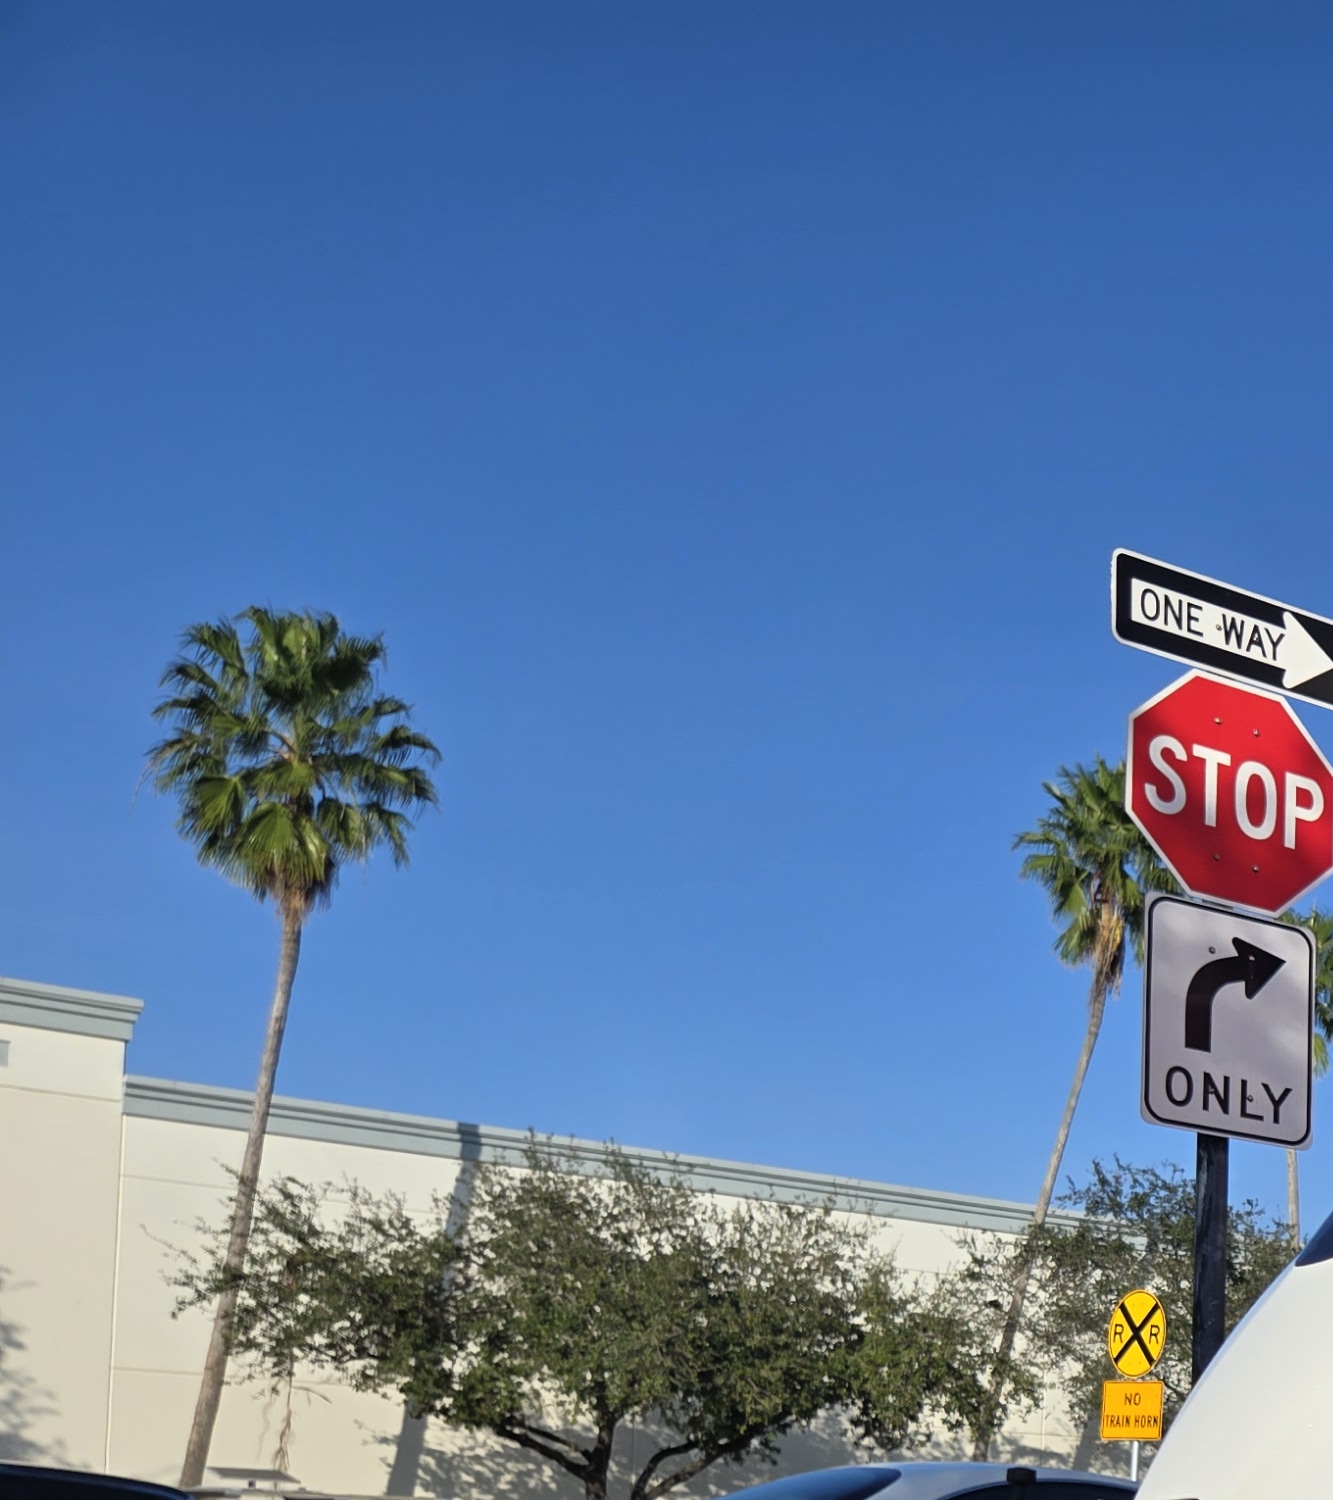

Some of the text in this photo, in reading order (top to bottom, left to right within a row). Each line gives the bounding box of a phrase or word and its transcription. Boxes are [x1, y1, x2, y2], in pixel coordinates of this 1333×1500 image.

[1140, 587, 1286, 662] ONE WAY
[1144, 734, 1325, 850] STOP
[1165, 1066, 1293, 1125] ONLY
[1105, 1414, 1159, 1429] TRAIN HORN
[1124, 1392, 1141, 1407] NO
